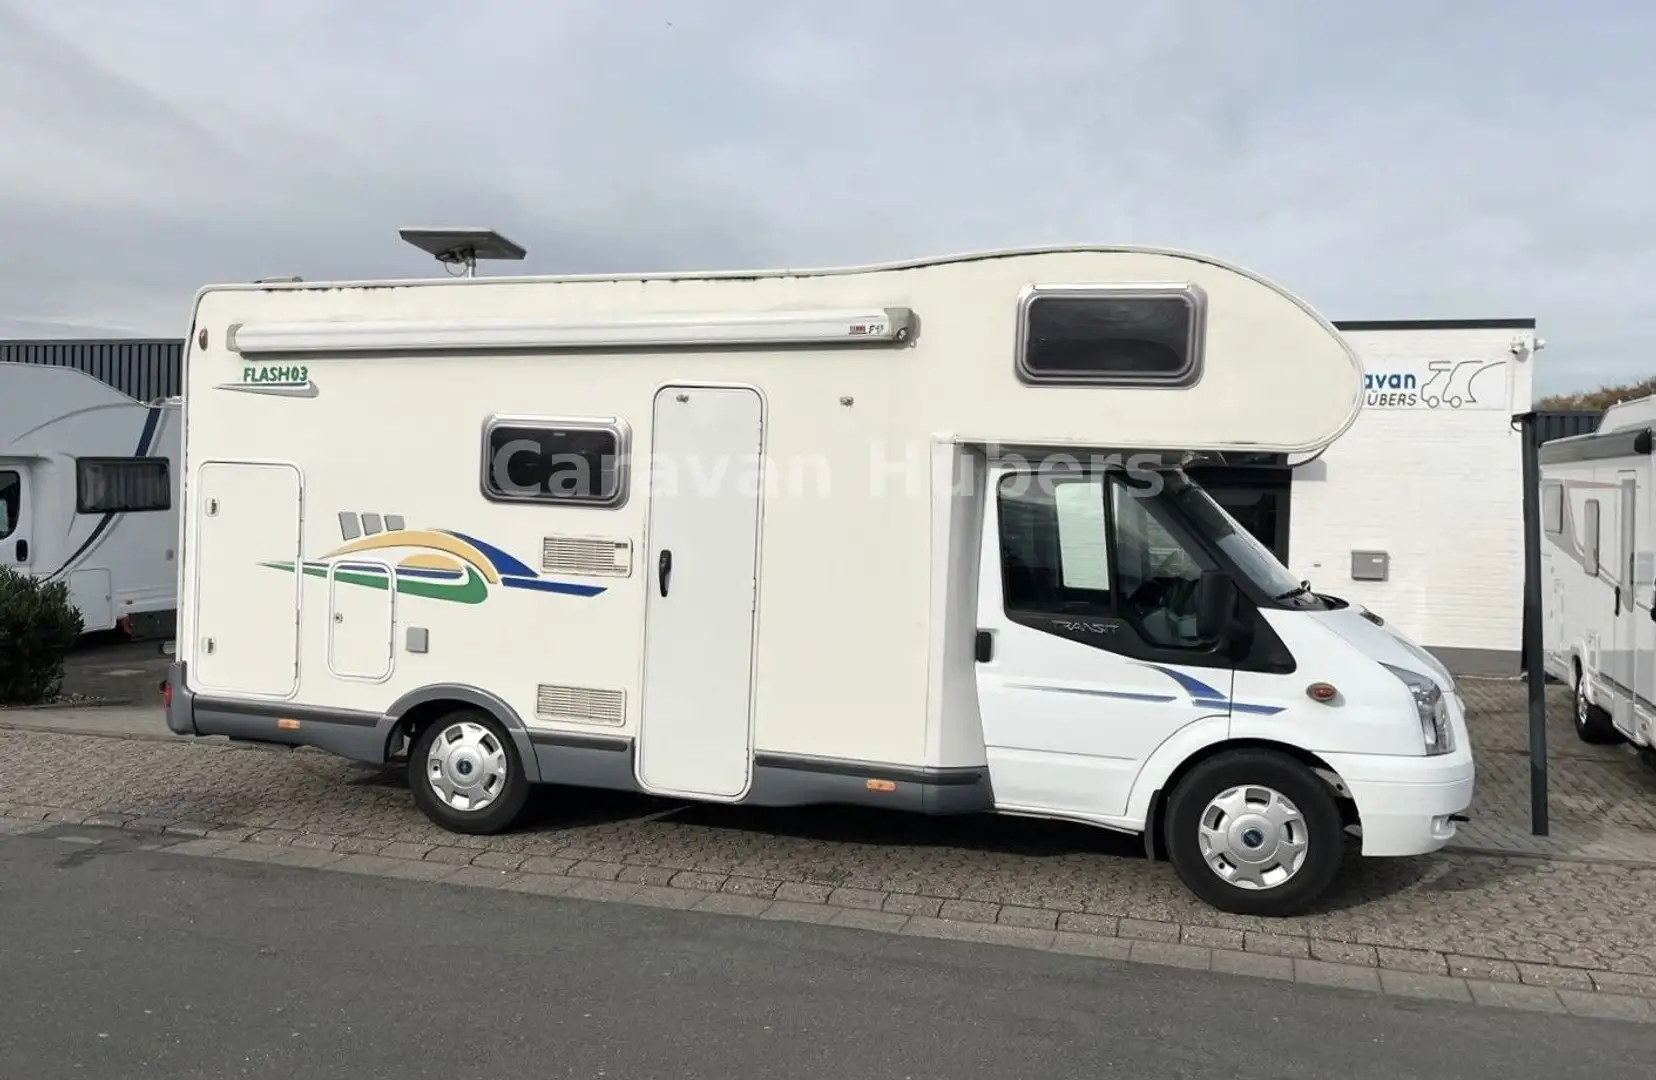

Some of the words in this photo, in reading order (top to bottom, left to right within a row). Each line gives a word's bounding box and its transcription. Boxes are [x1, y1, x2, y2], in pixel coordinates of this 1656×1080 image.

[243, 366, 308, 382] FLASH03
[1367, 390, 1417, 407] ÜBERS
[1051, 619, 1120, 636] TRANSIT
